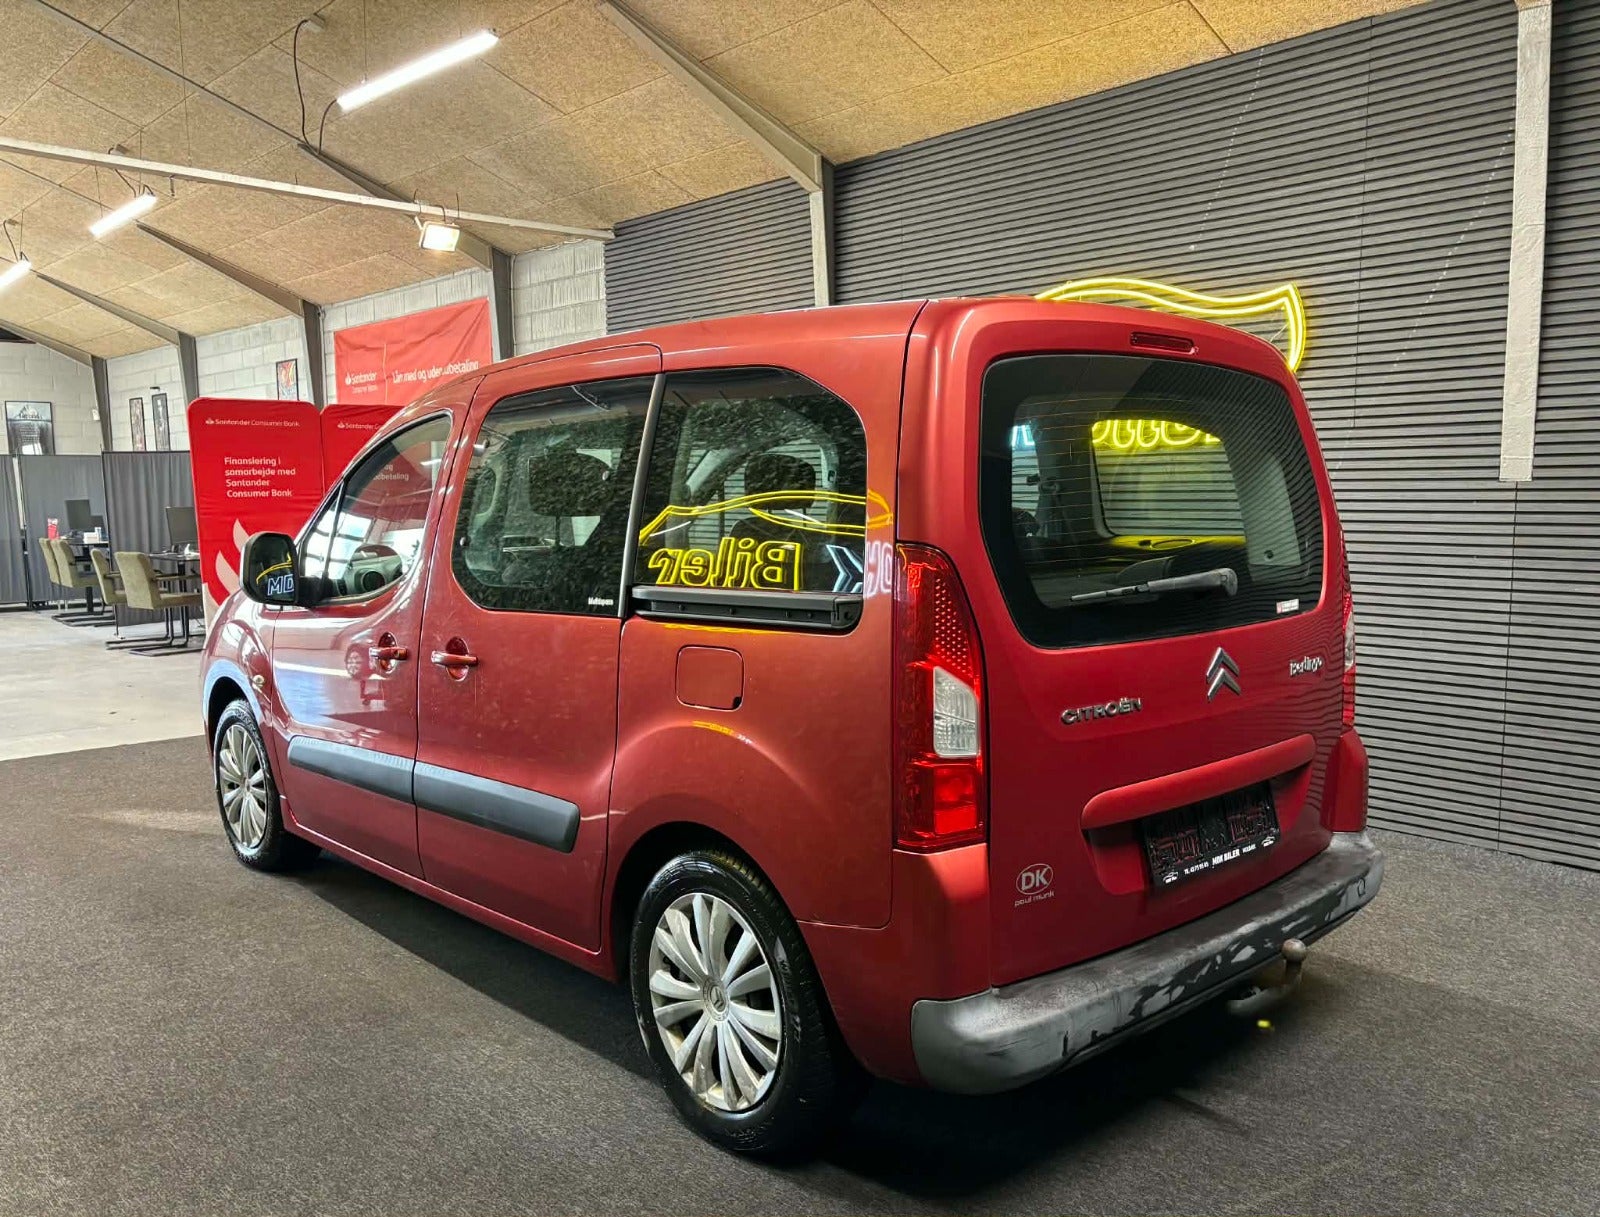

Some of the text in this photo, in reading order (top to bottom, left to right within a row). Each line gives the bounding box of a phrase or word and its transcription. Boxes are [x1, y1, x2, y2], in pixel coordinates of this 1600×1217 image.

[417, 369, 427, 383] og
[215, 418, 251, 427] Santander
[251, 419, 281, 427] Consumer
[345, 423, 374, 431] Santander
[224, 457, 277, 467] Finansiering
[225, 468, 296, 478] samarbejde med
[226, 479, 270, 487] Santander
[226, 489, 293, 498] Consumer Bank
[1061, 698, 1142, 724] CITROËN
[1021, 867, 1049, 891] DK
